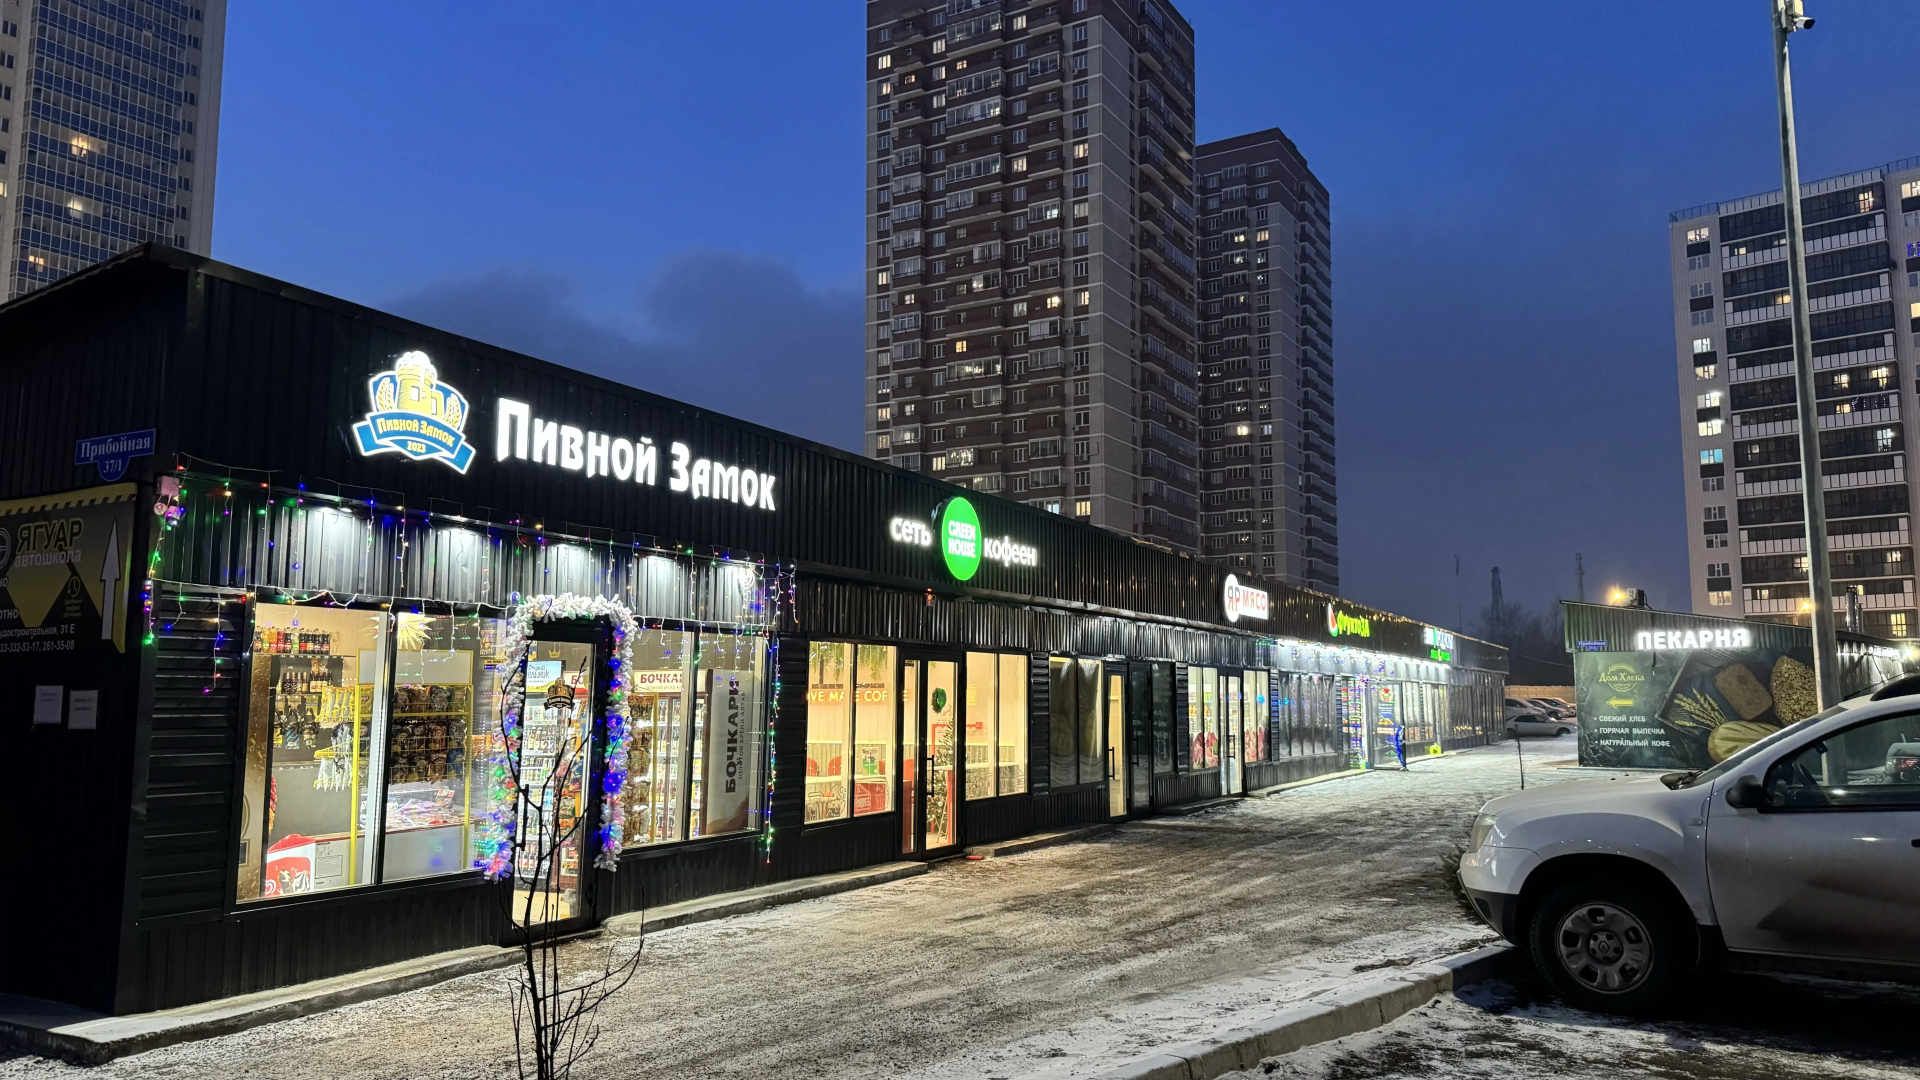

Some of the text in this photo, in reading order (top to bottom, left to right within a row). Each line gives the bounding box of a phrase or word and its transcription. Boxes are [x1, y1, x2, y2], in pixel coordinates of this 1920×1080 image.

[81, 436, 151, 460] Прибойная
[103, 459, 122, 473] 37/1
[17, 518, 84, 553] ЯГУАР
[890, 517, 932, 547] сеть
[948, 520, 976, 541] GREEN
[948, 537, 976, 558] HOUSE
[983, 536, 1038, 566] кофеен
[14, 550, 82, 568] автошкола
[1243, 589, 1266, 611] МЯСО
[60, 624, 69, 634] 31
[1637, 628, 1750, 650] ПЕКАРНЯ
[42, 639, 75, 651] 261-35-08
[1599, 714, 1646, 723] СВЕЖИЙ ХЛЕБ
[725, 680, 740, 793] БОЧКАРИ
[1600, 738, 1649, 747] НАТУРАЛЬНЫЙ
